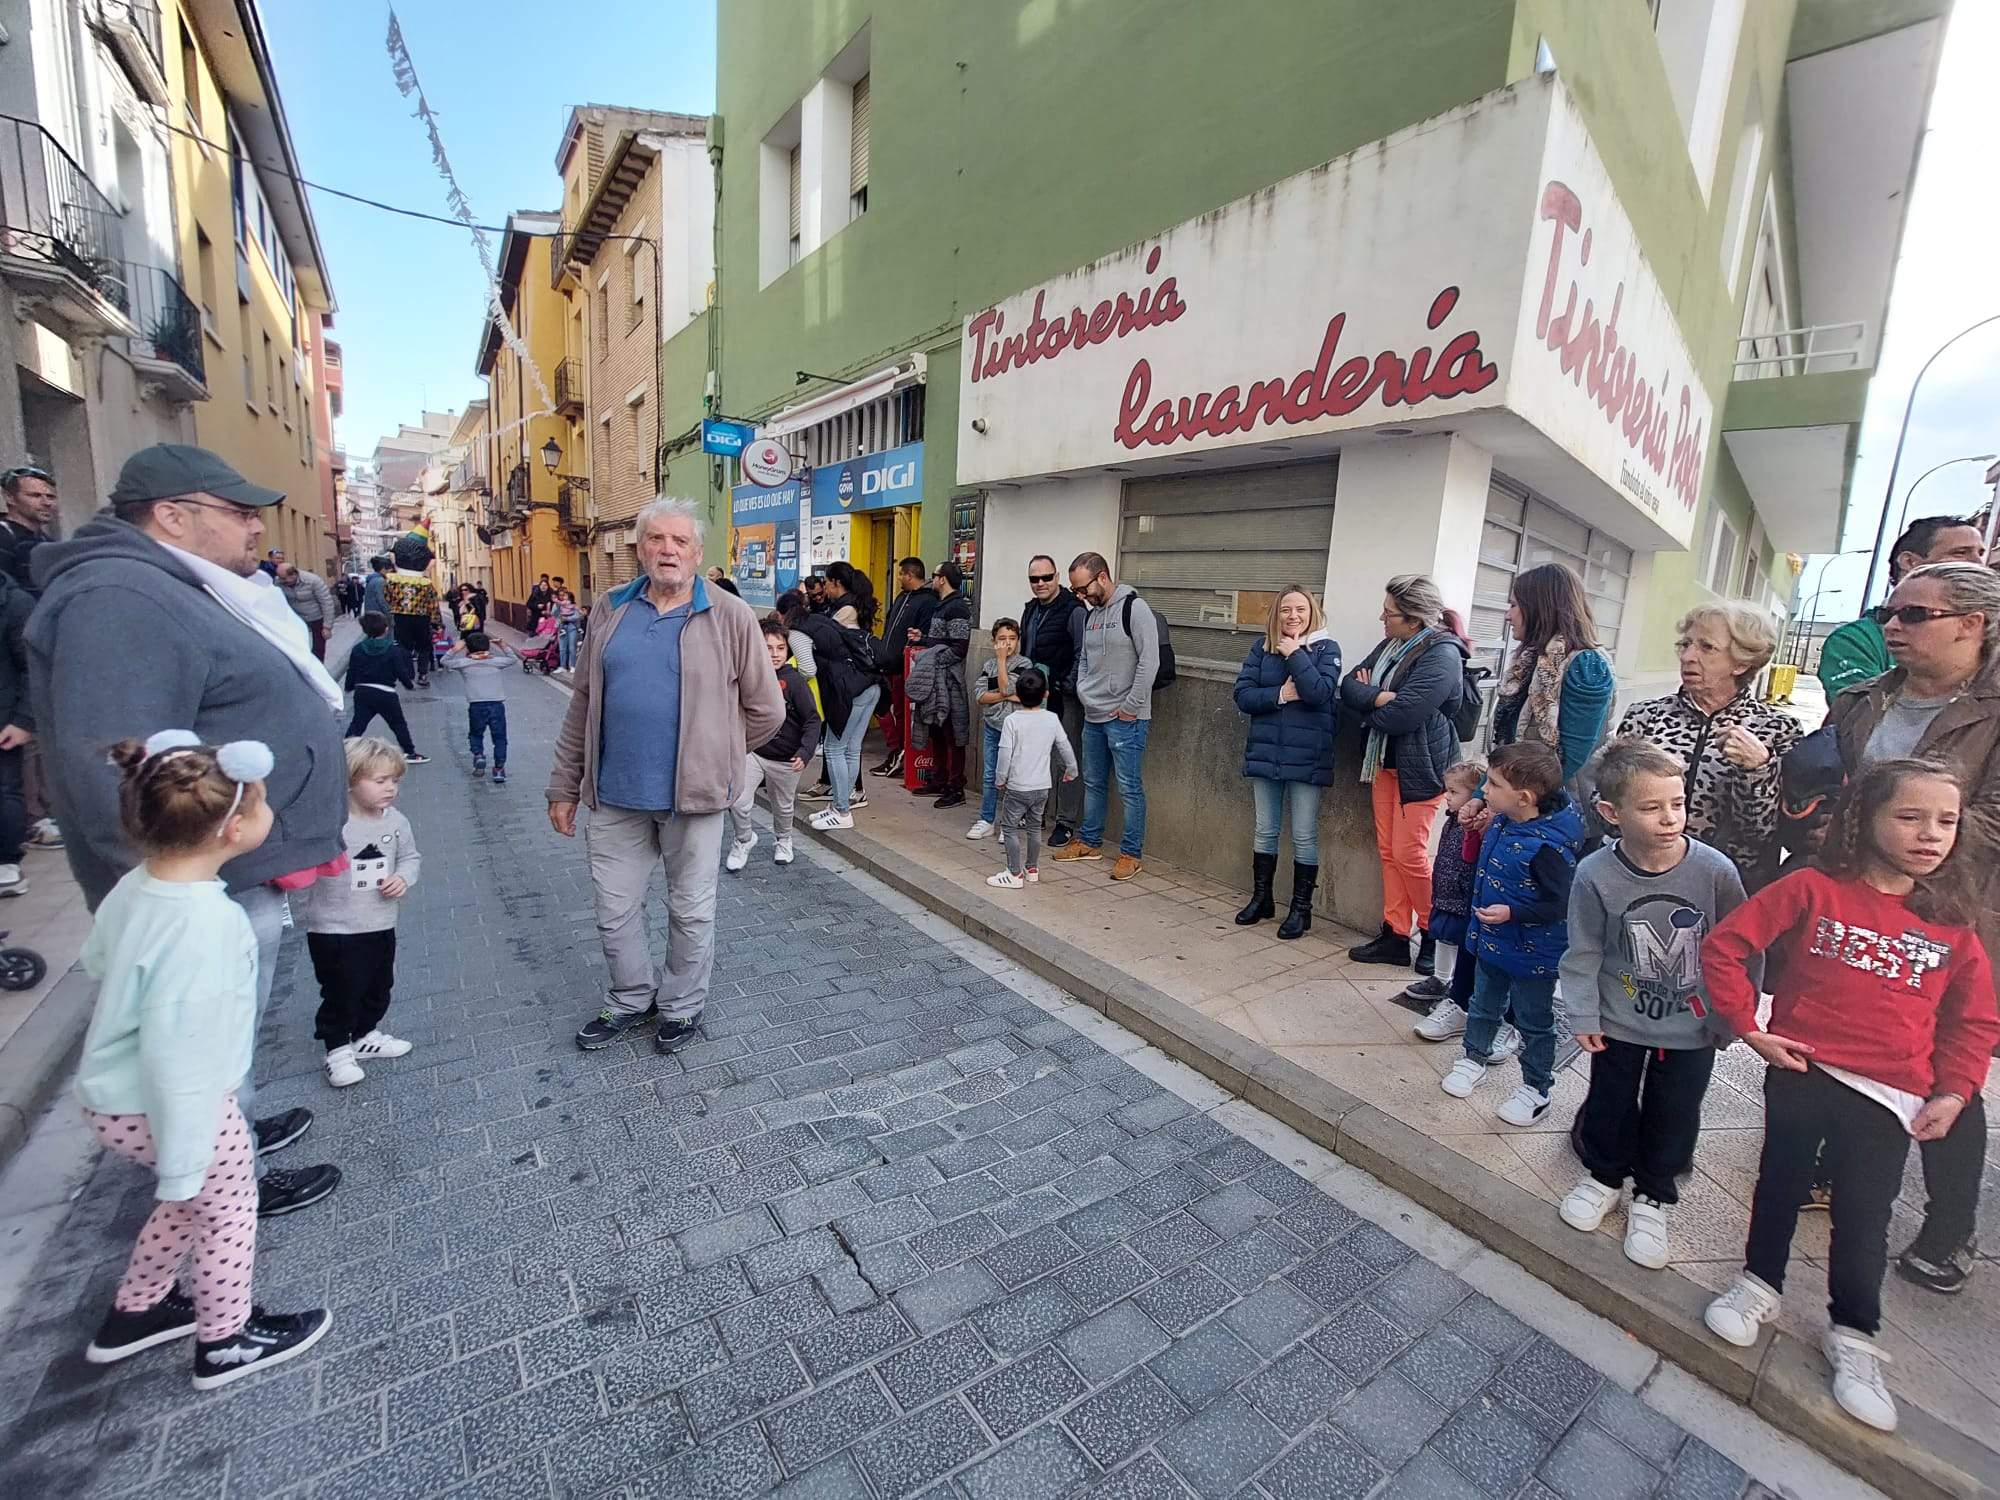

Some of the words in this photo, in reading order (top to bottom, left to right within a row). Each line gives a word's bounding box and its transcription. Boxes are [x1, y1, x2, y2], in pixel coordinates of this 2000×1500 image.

[706, 433, 742, 447] DIGI
[861, 461, 915, 495] DIGI
[757, 495, 764, 509] ES
[764, 493, 771, 508] LO
[770, 491, 782, 507] QUE
[782, 488, 796, 505] HAY
[777, 557, 797, 570] DIGI
[1626, 919, 1703, 990] M
